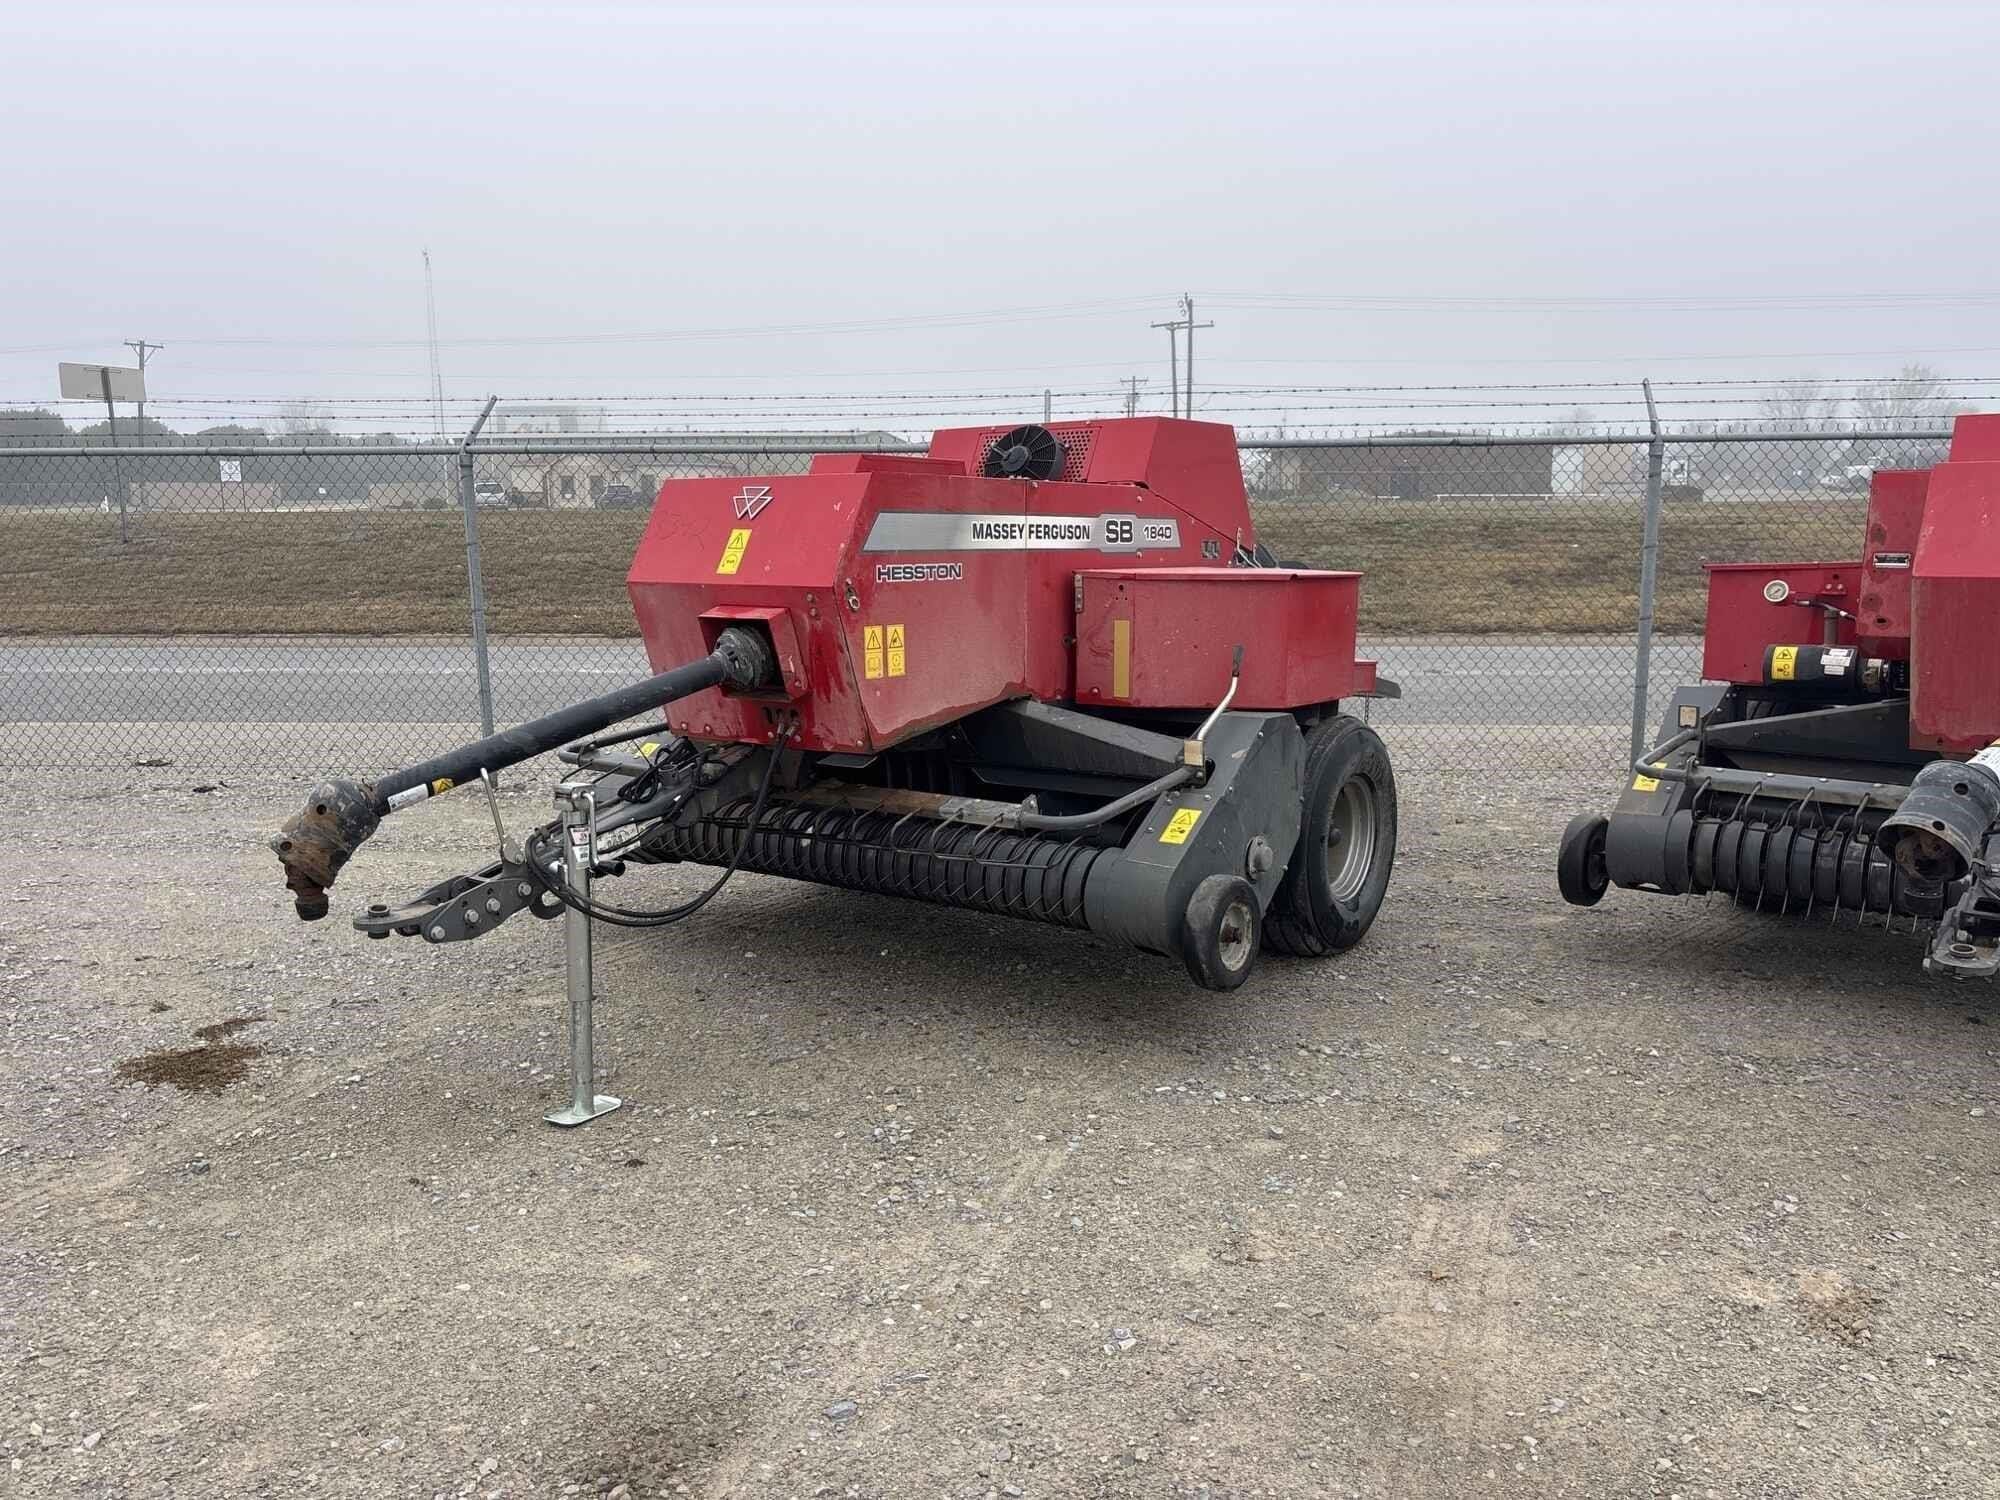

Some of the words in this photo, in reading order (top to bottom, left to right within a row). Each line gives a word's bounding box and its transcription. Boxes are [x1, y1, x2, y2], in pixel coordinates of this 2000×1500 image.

[972, 522, 1025, 541] MASSEY
[1028, 523, 1091, 541] FERGUSON
[1105, 519, 1134, 544] SB
[1143, 525, 1172, 541] 1840
[876, 564, 962, 582] HESSTON
